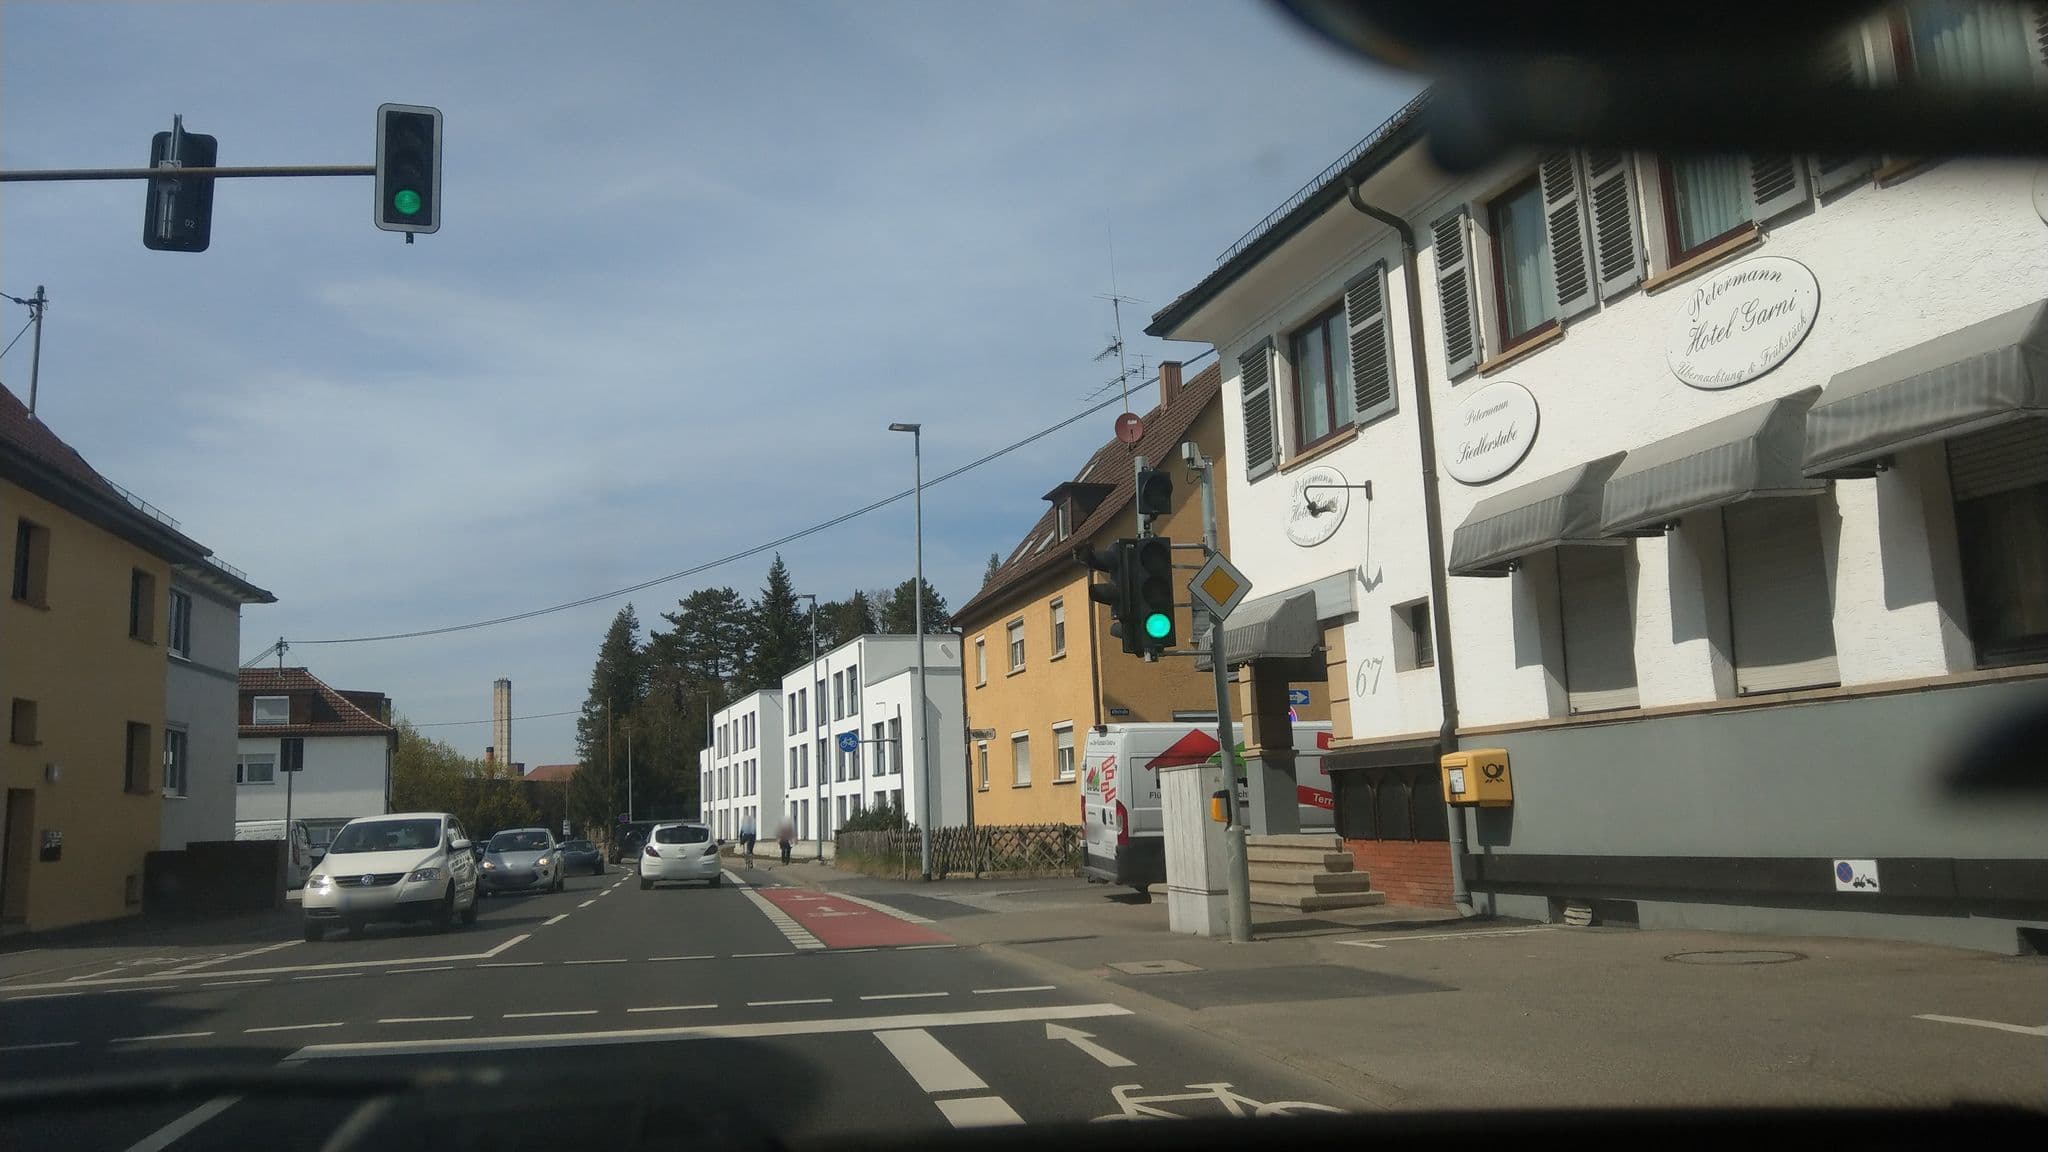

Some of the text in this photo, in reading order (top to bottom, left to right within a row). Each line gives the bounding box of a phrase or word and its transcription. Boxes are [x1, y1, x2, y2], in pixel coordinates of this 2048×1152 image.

[1687, 268, 1783, 323] Petermann
[1685, 288, 1799, 357] Hotel Garni
[1676, 360, 1745, 384] Übernachtung
[1465, 400, 1510, 427] Petermann
[1456, 420, 1519, 465] Siedlerstube
[1355, 655, 1385, 698] 67
